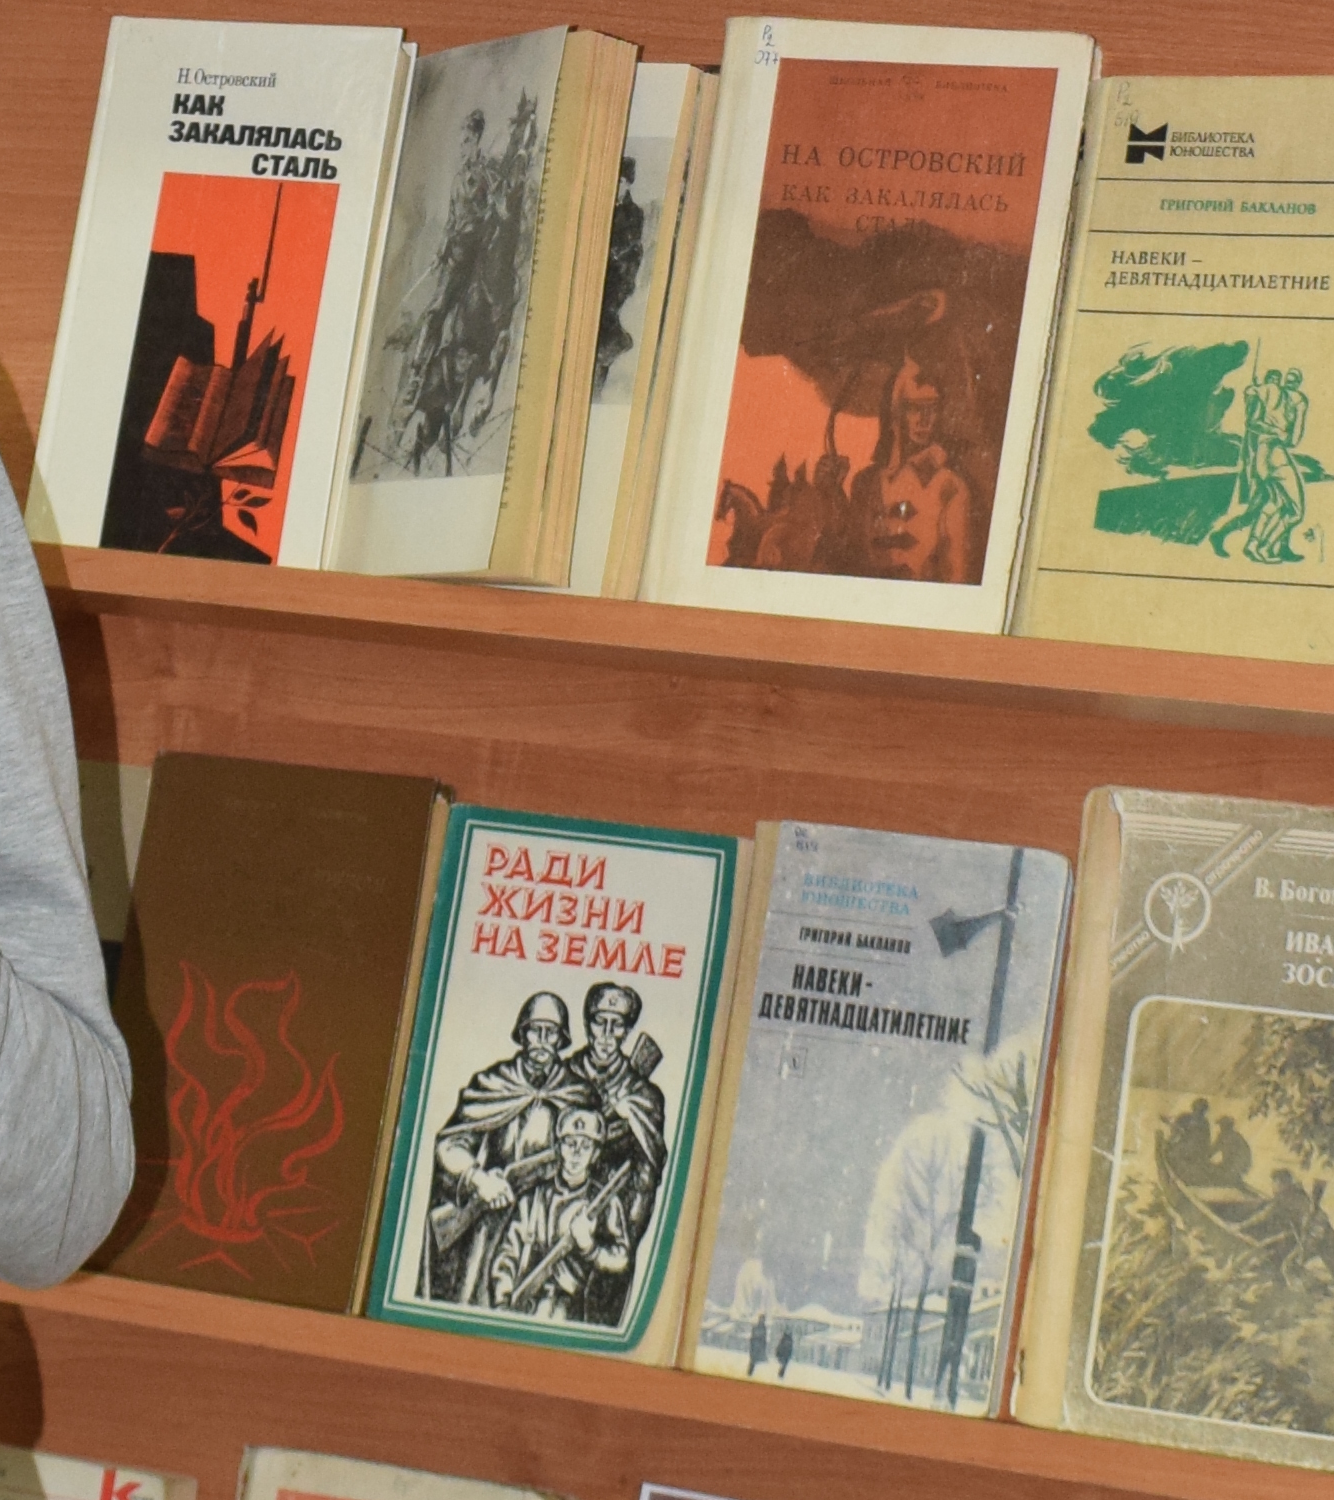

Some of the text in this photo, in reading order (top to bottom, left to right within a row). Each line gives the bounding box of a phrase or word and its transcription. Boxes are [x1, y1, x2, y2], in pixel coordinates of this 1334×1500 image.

[172, 92, 225, 117] КАК
[168, 120, 343, 152] ЗАКАЛЯЛАСЬ
[1170, 129, 1256, 145] БИБЛИОТЕКА
[838, 146, 1027, 178] ОСТРОВСКИЙ
[1169, 144, 1256, 159] ЮНОШЕСТВА
[251, 153, 338, 180] СТАЛЬ
[781, 183, 1009, 213] КАК ЗАКАЛЯЛАСЬ
[1159, 197, 1317, 216] ГРИГОРИЙ БАКЛАНОВ
[1111, 249, 1186, 267] НАВЕКИ
[1104, 270, 1331, 292] ДЕВЯТНАДЦАТИЛЕТНИЕ
[483, 841, 607, 890] РАДИ
[803, 872, 919, 900] БИБЛИОТЕКА
[1254, 876, 1276, 900] В.
[477, 881, 645, 935] ЖИЗНИ
[800, 889, 911, 917] ЮНОШЕСТВА
[471, 920, 687, 979] НА ЗЕМЛЕ
[792, 963, 863, 998] НАВЕКИ
[758, 992, 971, 1046] ДЕВЯТНАДЦАТИЛЕТНИЕ
